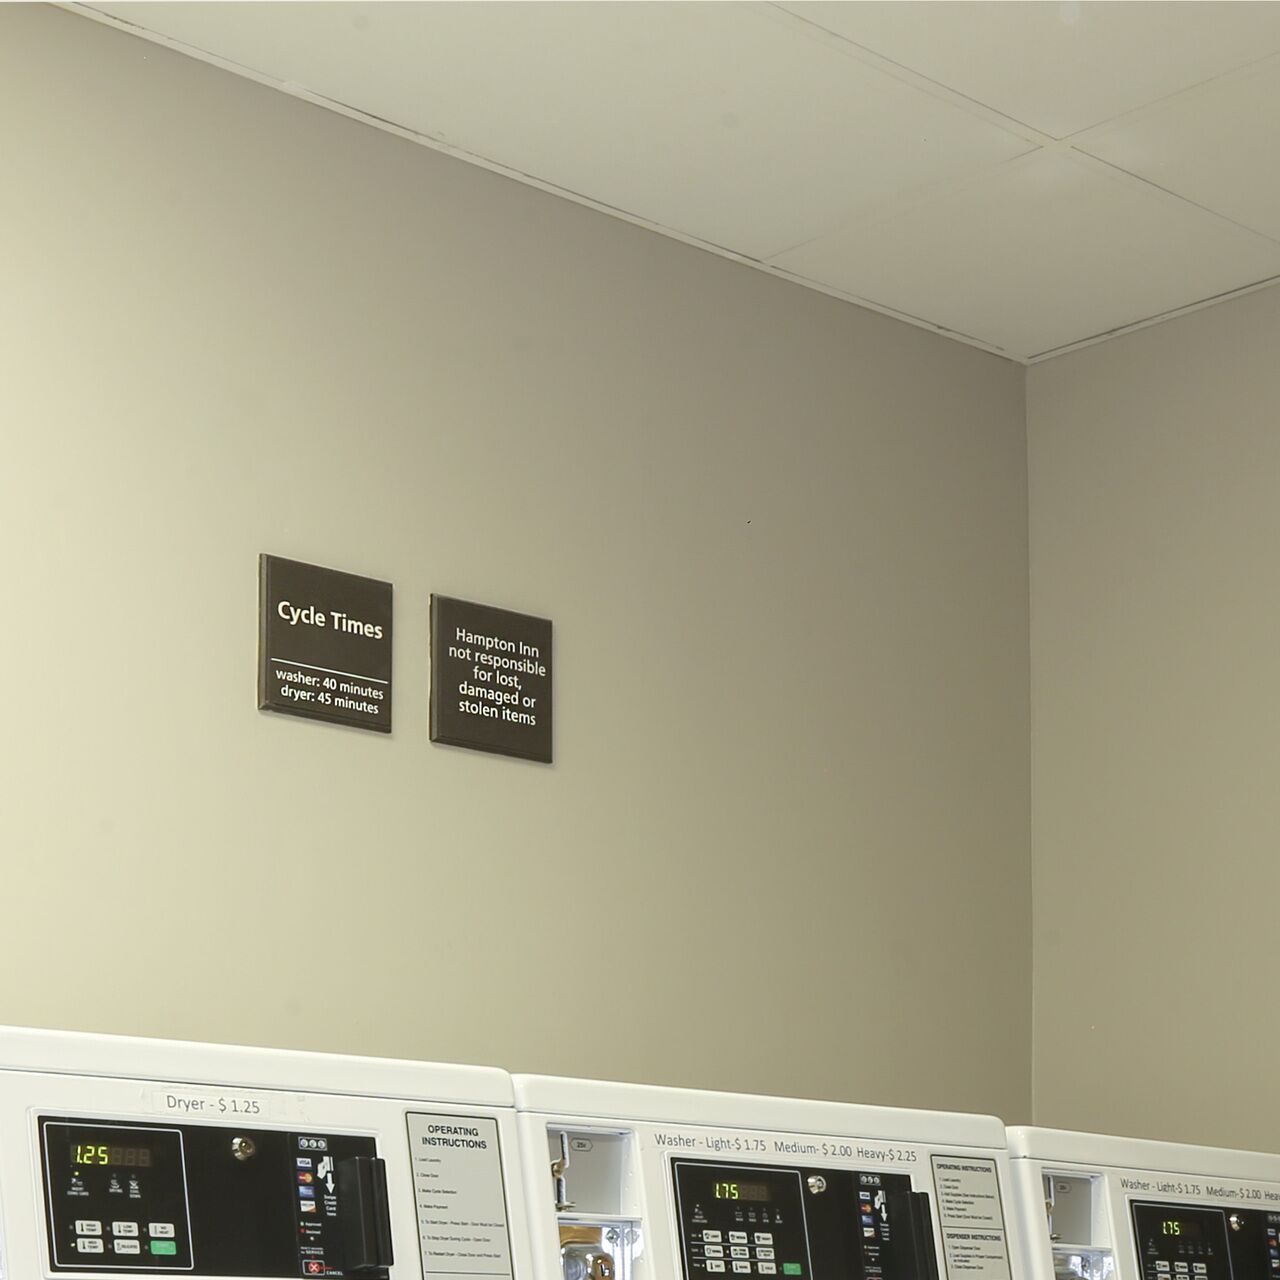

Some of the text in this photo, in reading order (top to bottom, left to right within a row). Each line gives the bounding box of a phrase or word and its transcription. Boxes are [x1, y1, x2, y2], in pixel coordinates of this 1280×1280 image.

[278, 601, 383, 639] Cycle Times
[456, 627, 539, 658] Hampton Inn
[449, 646, 546, 676] not responsible
[275, 670, 384, 700] washer: 40 minutes
[473, 666, 521, 690] for lost,
[280, 685, 379, 714] dryer: 45 minutes
[459, 681, 536, 708] damaged or
[459, 700, 536, 726] stolen items
[167, 1095, 260, 1114] Dryer $ 1.25
[422, 1137, 487, 1149] INSTRUCTIONS
[428, 1125, 478, 1136] OPERATING
[77, 1145, 108, 1164] 1.25
[655, 1134, 696, 1147] Washer
[744, 1139, 766, 1151] 1.75
[831, 1144, 852, 1157] 2.00
[897, 1150, 917, 1162] 2.25
[1120, 1178, 1150, 1190] Washer
